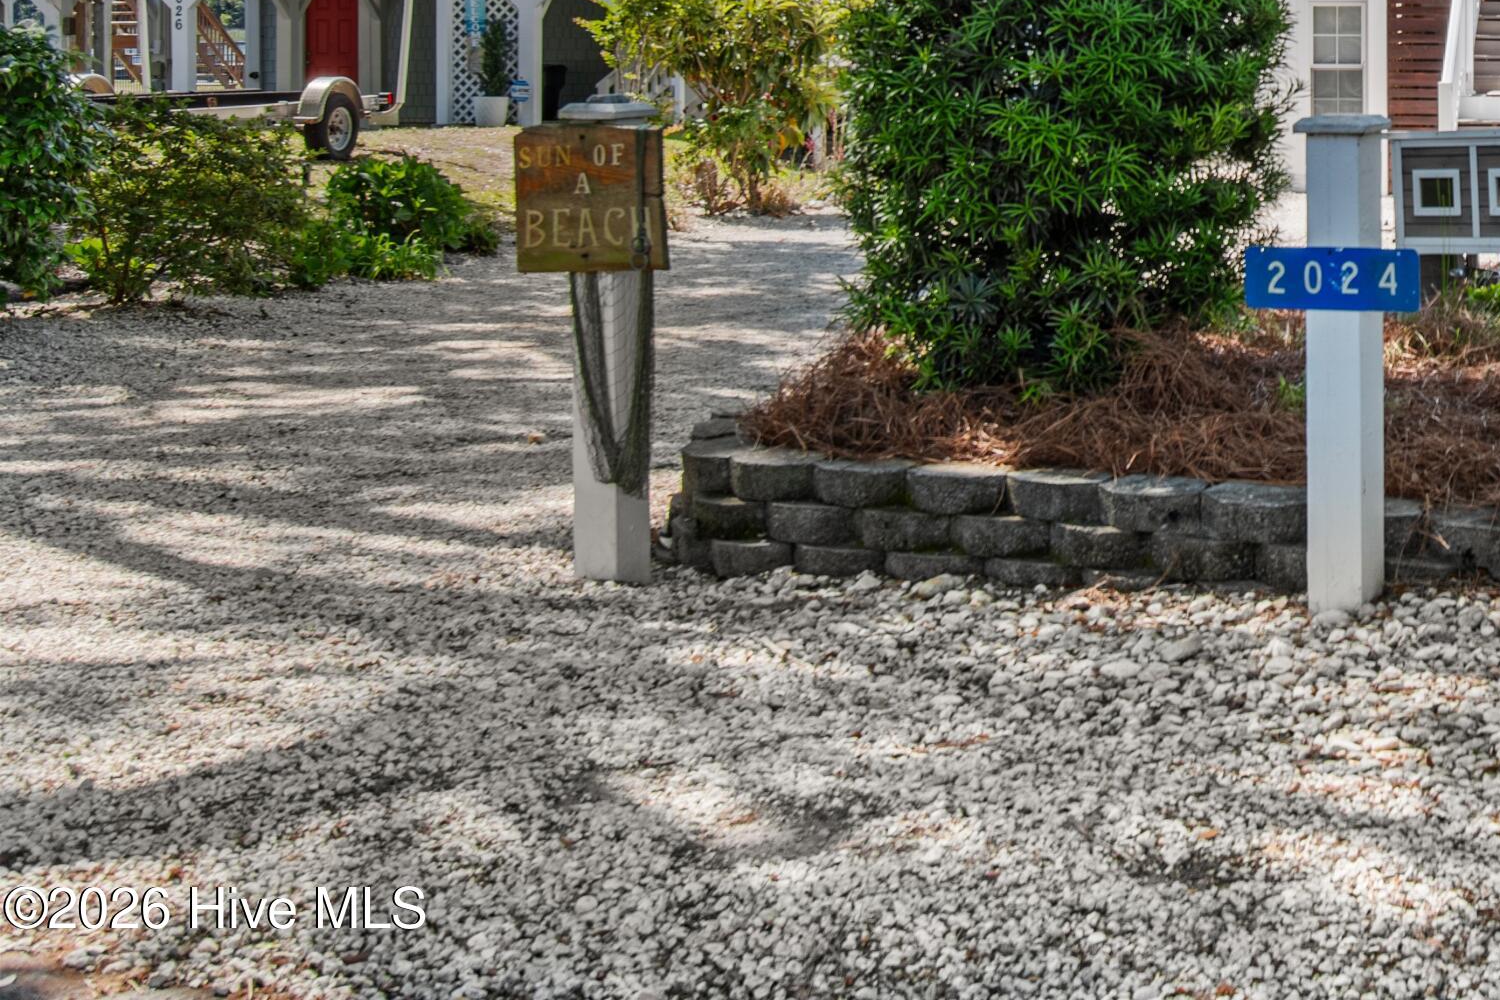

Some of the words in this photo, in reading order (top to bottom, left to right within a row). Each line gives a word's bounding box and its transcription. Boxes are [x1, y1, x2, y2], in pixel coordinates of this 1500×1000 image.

[518, 145, 572, 169] SUN
[592, 143, 625, 167] OF
[573, 172, 592, 195] A
[523, 207, 653, 248] BEACH
[1267, 260, 1398, 296] 2024
